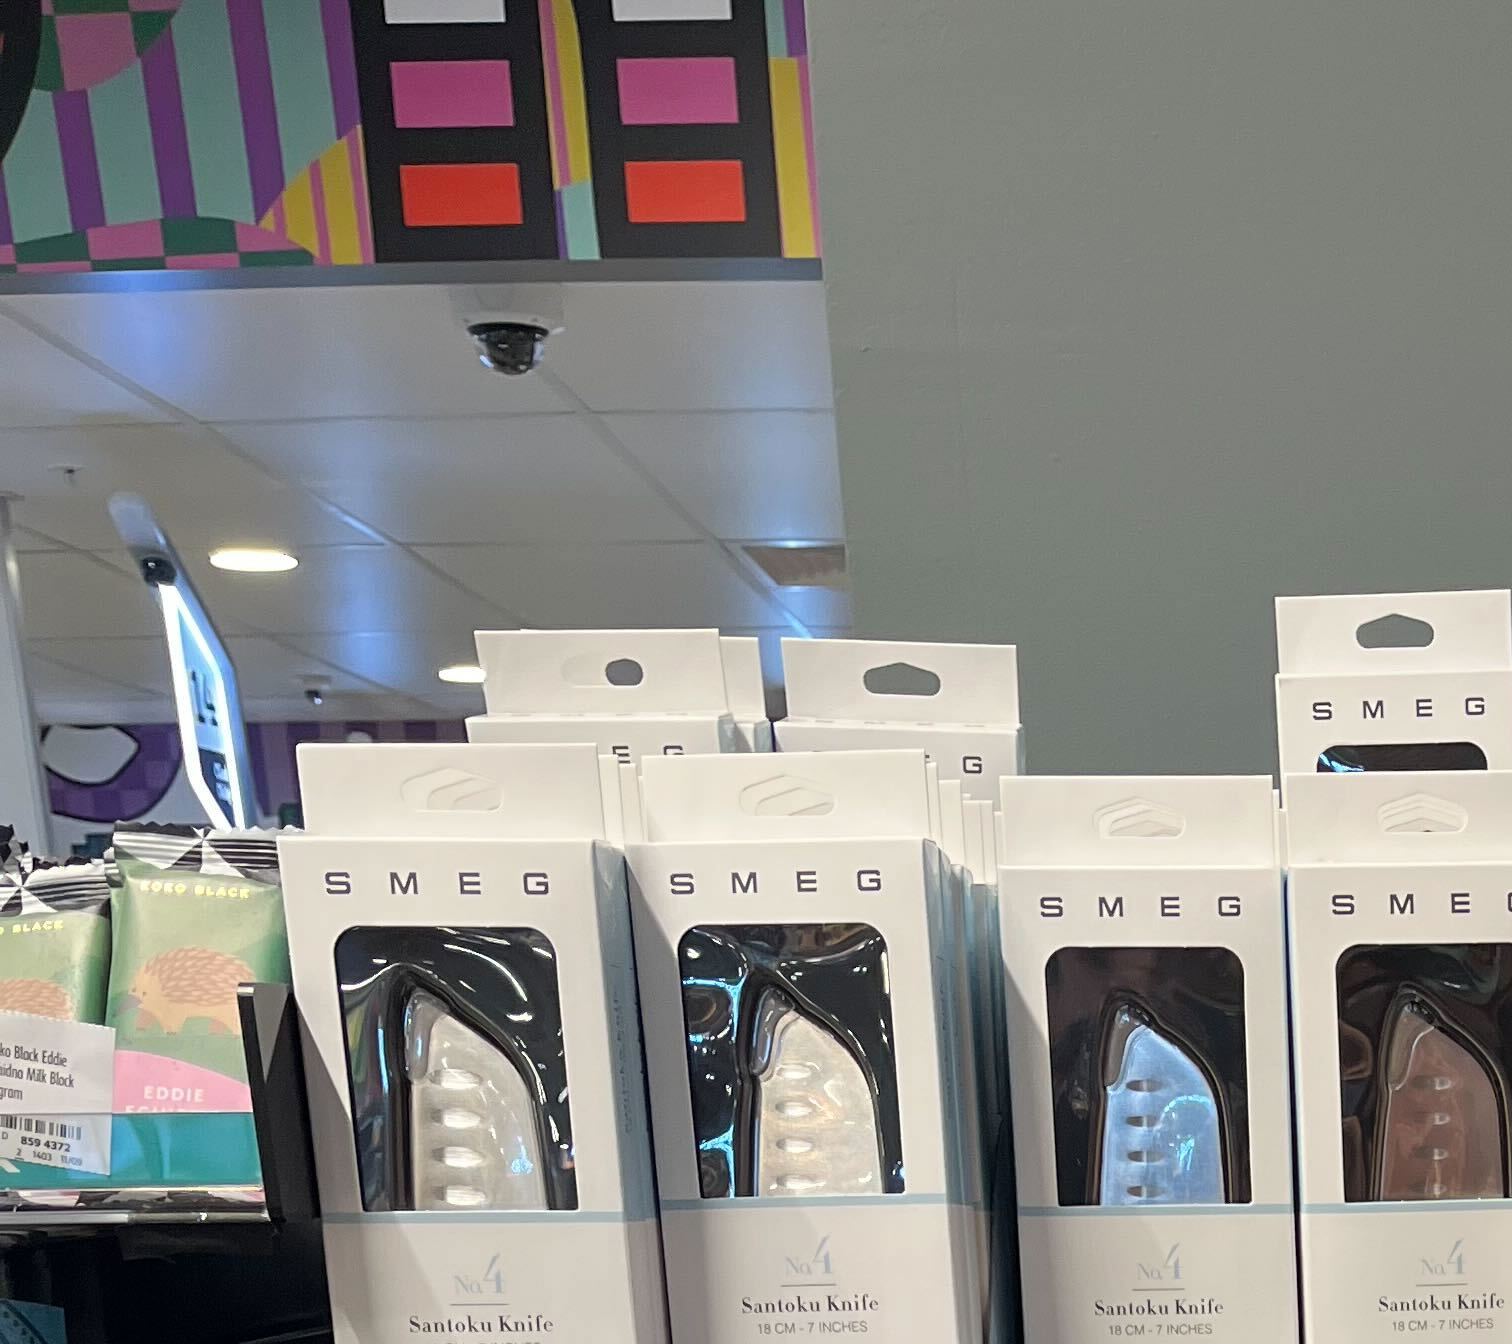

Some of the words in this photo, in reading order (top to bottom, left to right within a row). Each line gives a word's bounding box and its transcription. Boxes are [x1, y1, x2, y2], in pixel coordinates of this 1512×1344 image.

[1312, 698, 1486, 720] SMEG
[140, 880, 186, 895] KOKO
[194, 884, 250, 899] BLACK
[325, 871, 550, 896] SMEG
[669, 869, 882, 895] SMEG
[1041, 897, 1241, 917] SMEG
[42, 1051, 68, 1067] Eddie
[26, 1067, 47, 1083] Milk
[50, 1072, 75, 1088] Block
[143, 1085, 205, 1102] EDDIE
[20, 1136, 41, 1147] 859
[44, 1140, 71, 1152] 4372
[741, 1297, 820, 1315] Santoku
[827, 1294, 879, 1312] Knife
[1094, 1299, 1169, 1317] Santoku
[1175, 1298, 1224, 1315] Knife
[1378, 1295, 1453, 1313] Santoku
[1458, 1293, 1505, 1311] Knife
[409, 1315, 492, 1333] Santoku
[499, 1314, 553, 1333] Knife
